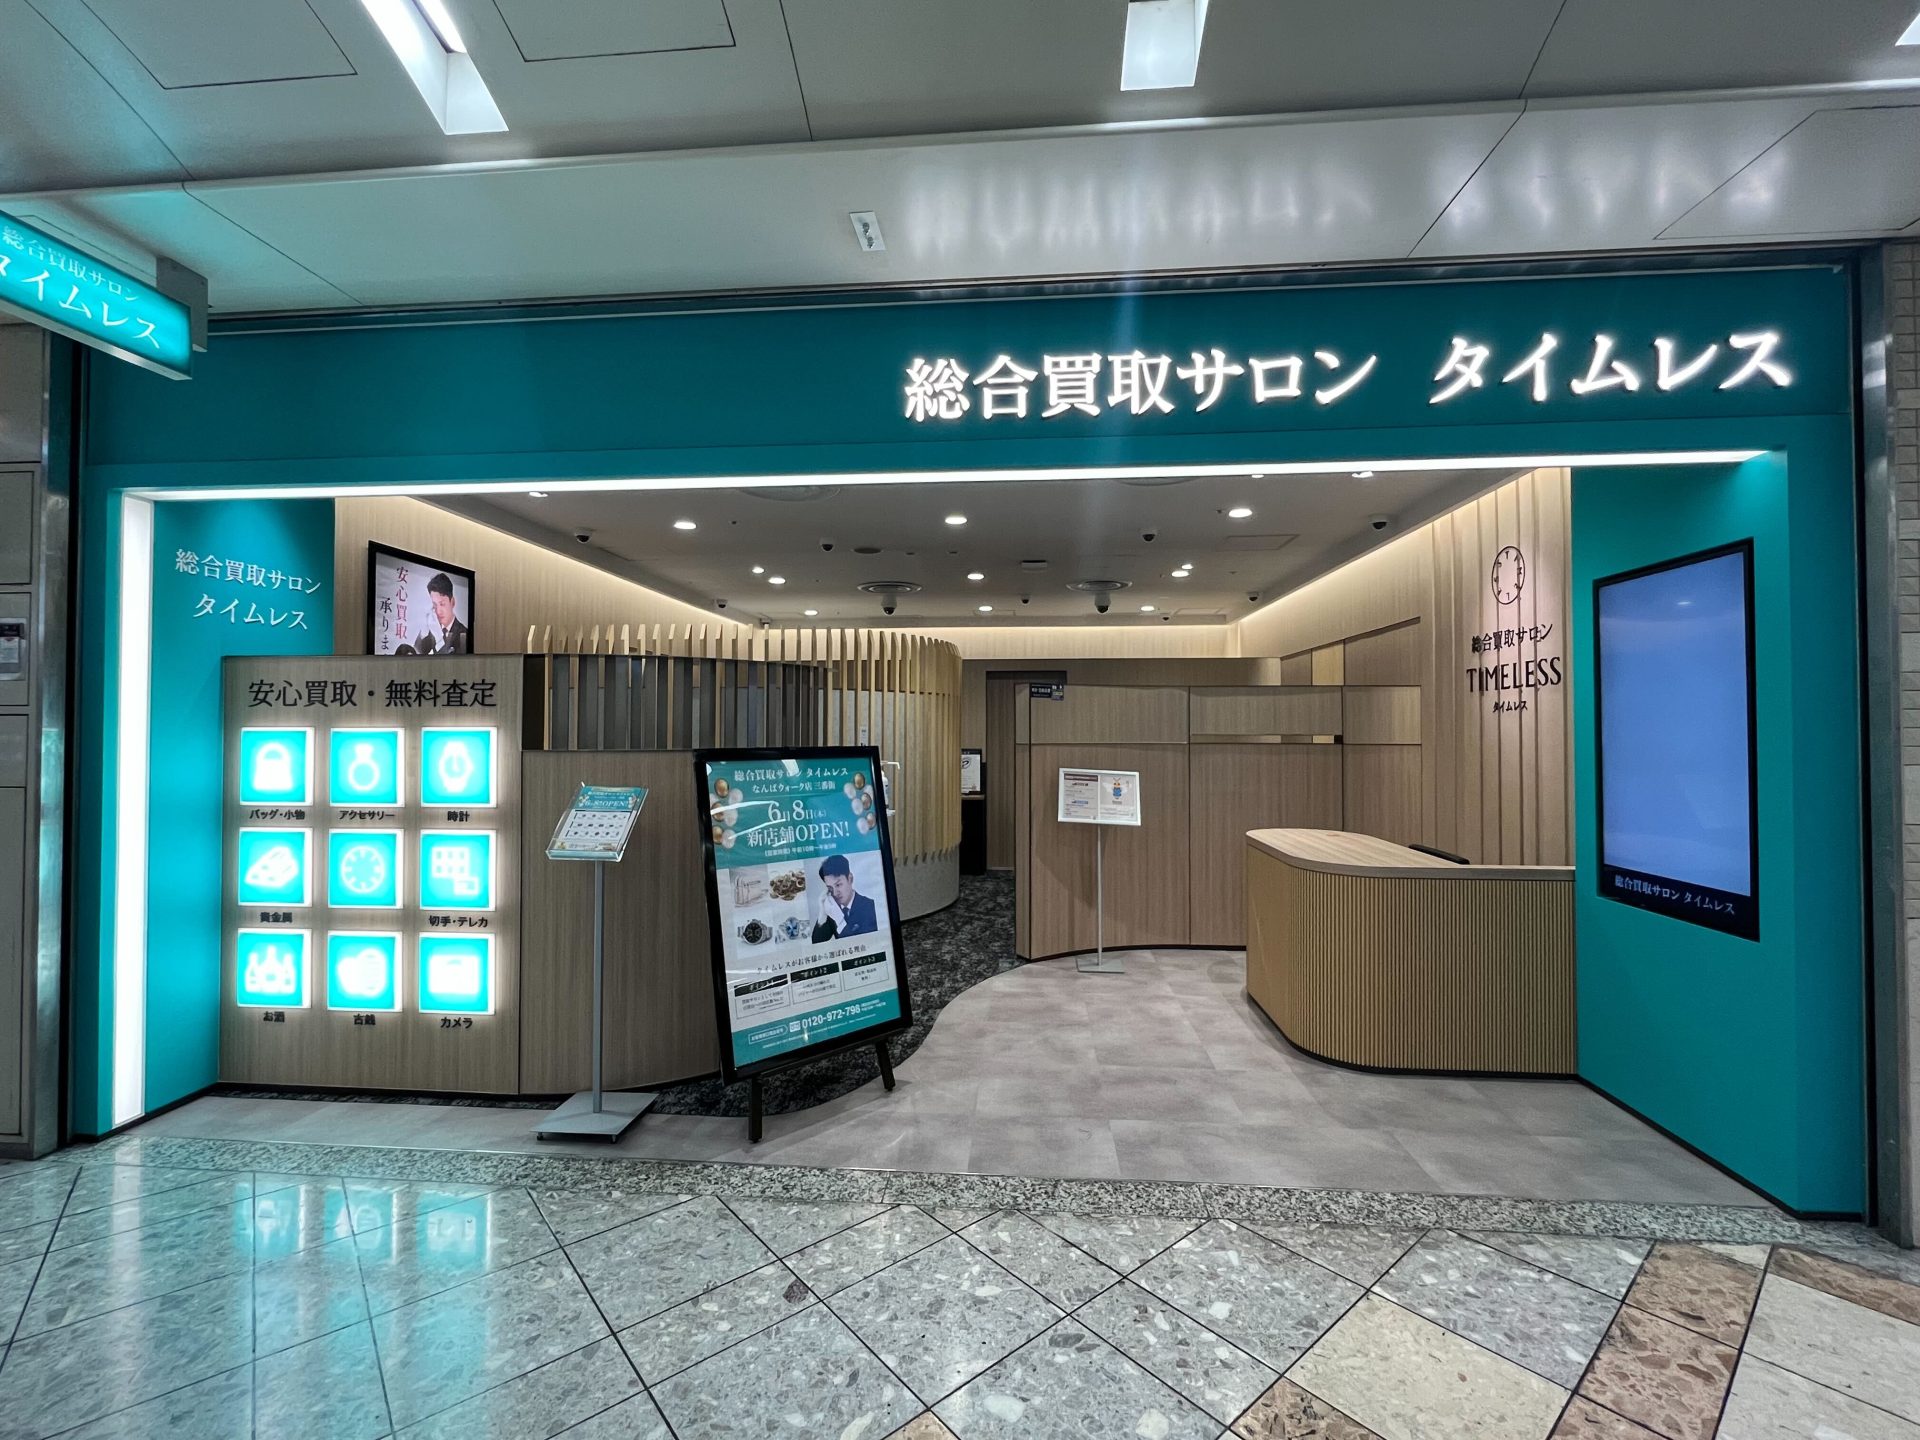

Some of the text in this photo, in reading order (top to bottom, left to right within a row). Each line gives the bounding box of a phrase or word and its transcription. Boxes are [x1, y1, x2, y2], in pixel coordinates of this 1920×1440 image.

[3, 226, 139, 301] 総合買取サロン
[904, 328, 1795, 424] 総合買取サロン タイムレス
[175, 548, 322, 595] 総合買取サロン
[192, 593, 308, 630] タイムレス
[395, 566, 409, 641] 安心買取
[379, 597, 394, 655] 承りま
[1472, 623, 1553, 653] 総合買取サロン
[1466, 656, 1562, 693] TIMELESS
[248, 679, 497, 708] 安心買取・無料査定
[1493, 701, 1528, 713] タイムレス
[806, 766, 849, 777] タイムレス
[752, 783, 813, 793] なんばウォーク店
[249, 809, 305, 821] バッグ・小物
[339, 810, 395, 820] アクセサリー
[447, 810, 470, 822] 時計
[1614, 874, 1736, 916] 総合買取サロン タイムレス
[429, 915, 488, 928] 切手・テレカ
[263, 1011, 285, 1023] お酒
[353, 1014, 376, 1026] 古銭
[440, 1017, 473, 1029] カメラ
[801, 1004, 861, 1029] 0120-972-798
